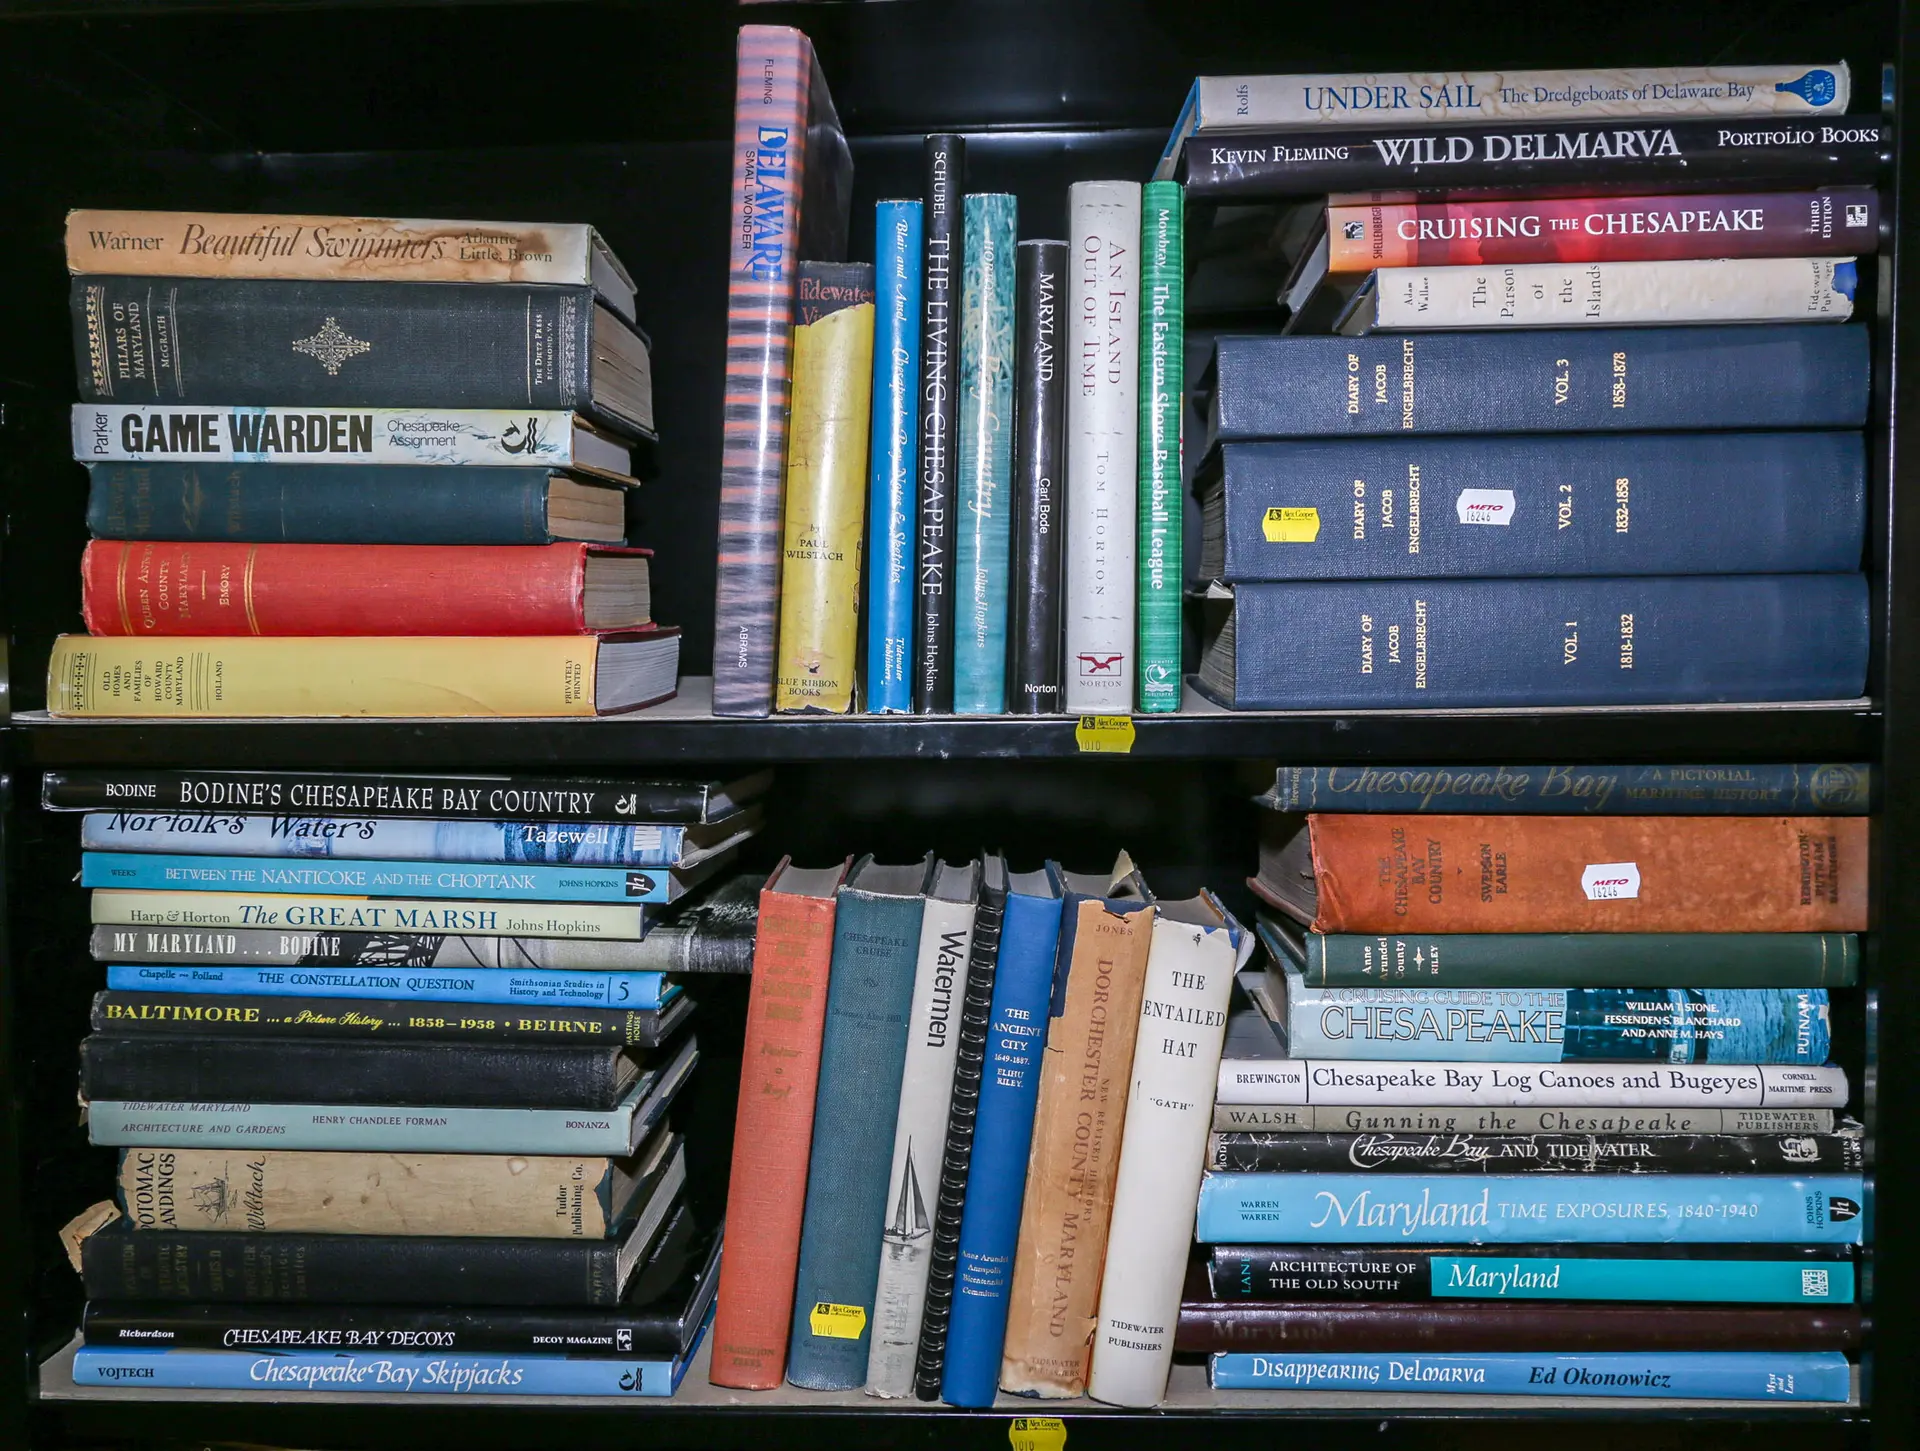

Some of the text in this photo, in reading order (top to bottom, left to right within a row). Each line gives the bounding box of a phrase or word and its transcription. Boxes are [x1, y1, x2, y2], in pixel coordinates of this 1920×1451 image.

[763, 58, 774, 105] FLEMING
[1303, 82, 1756, 111] UNDER SAIL The Dredgeboats of Delaware Bay
[1372, 129, 1682, 166] WILD DELMARVA
[1717, 127, 1879, 147] PORTFOLIO BOOKS
[1211, 145, 1350, 165] KEVIN FLEMING
[933, 151, 947, 218] SCHUBEL
[742, 151, 755, 250] SMALL WONDER
[1397, 208, 1765, 241] CRUISING THE CHESAPEAKE
[88, 223, 447, 261] Warner Beautiful Swimmers
[895, 219, 908, 322] Blair and Ansel
[1404, 281, 1414, 306] Adam
[1500, 267, 1515, 319] Parson
[1562, 278, 1573, 304] the
[1585, 264, 1601, 318] Islands
[128, 301, 146, 379] MARYLAND
[1039, 272, 1054, 382] MARYLAND
[1375, 363, 1387, 404] JACOB
[1402, 339, 1415, 430] ENGELBRECHT
[1555, 358, 1569, 405] VOL. 3
[387, 419, 460, 434] Chesapeake
[922, 232, 950, 596] THE LIVING CHESAPEAKE
[92, 411, 109, 455] Parker
[121, 413, 373, 453] GAME WARDEN
[388, 434, 456, 449] Assignment
[1039, 477, 1050, 535] Carl Bode
[1381, 488, 1393, 529] JACOB
[1408, 463, 1421, 555] ENGELBRECHT
[1466, 503, 1504, 511] METO
[1558, 484, 1572, 530] VOL. 2
[786, 550, 844, 561] WILSTACH
[799, 539, 829, 548] PAUL
[738, 625, 749, 669] ABRAMS
[1388, 623, 1400, 664] JACOB
[1415, 599, 1428, 690] ENGELBRECHT
[1564, 620, 1578, 665] VOL. 1
[885, 637, 894, 682] Publishers
[895, 637, 904, 682] Tidewater
[103, 671, 111, 691] OLD
[113, 665, 122, 697] HOMES
[134, 660, 143, 702] FAMILIES
[144, 674, 152, 688] OF
[155, 660, 163, 701] HOWARD
[165, 662, 173, 700] COUNTY
[176, 656, 184, 706] MARYLAND
[565, 658, 573, 704] PRIVATELY
[574, 663, 582, 700] PRINTED
[789, 688, 821, 696] BOOKS
[1024, 683, 1057, 693] Norton
[1079, 679, 1122, 688] NORTON
[106, 781, 595, 815] BODINE BODINE'S CHESAPEAKE BAY COUNTRY
[523, 824, 609, 845] Tazewell
[165, 867, 536, 890] BETWEEN THE NANTICOKE AND THE CHOPTANK
[1496, 852, 1507, 894] EARLE
[1593, 878, 1629, 886] METO
[238, 905, 498, 930] The GREAT MARSH
[1095, 923, 1134, 936] JONES
[1362, 945, 1372, 975] Anne
[1379, 937, 1388, 980] Arundel
[1430, 945, 1439, 975] RILEY
[258, 972, 475, 991] THE CONSTELLATION QUESTION
[926, 930, 968, 1049] Watermen
[1171, 970, 1206, 991] THE
[1143, 1000, 1226, 1028] ENTAILED
[1320, 1006, 1563, 1043] CHESAPEAKE
[1162, 1038, 1197, 1058] HAT
[1621, 1028, 1725, 1040] AND ANNE M. HAYS
[996, 1068, 1024, 1079] ELIHU
[1236, 1068, 1759, 1095] BREWINGTON Chesapeake Bay Log Canoes and Bugeyes
[1782, 1072, 1817, 1081] CORNELL
[1099, 1078, 1110, 1103] NEW
[1768, 1085, 1833, 1093] MARITIME PRESS
[122, 1101, 251, 1113] TIDEWATER MARYLAND
[312, 1115, 448, 1126] HENRY CHANDLEE FORMAN
[1229, 1110, 1692, 1133] WALSH Gunning the Chesapeake
[1739, 1111, 1817, 1122] TIDEWATER
[121, 1123, 286, 1135] ARCHITECTURE AND GARDENS
[565, 1121, 611, 1129] BONANZA
[1736, 1121, 1819, 1131] PUBLISHERS
[1083, 1169, 1098, 1222] HISTORY
[1241, 1200, 1280, 1208] WARREN
[1816, 1190, 1824, 1229] HOPKINS
[1241, 1213, 1280, 1221] WARREN
[1806, 1195, 1814, 1227] JOHNS
[1241, 1255, 1252, 1293] LANE
[1269, 1260, 1417, 1274] ARCHITECTURE OF
[1448, 1264, 1561, 1294] Maryland
[119, 1329, 456, 1347] Richardson CHESAPEAKE BAY DECOYS
[533, 1335, 614, 1345] DECOY MAGAZINE
